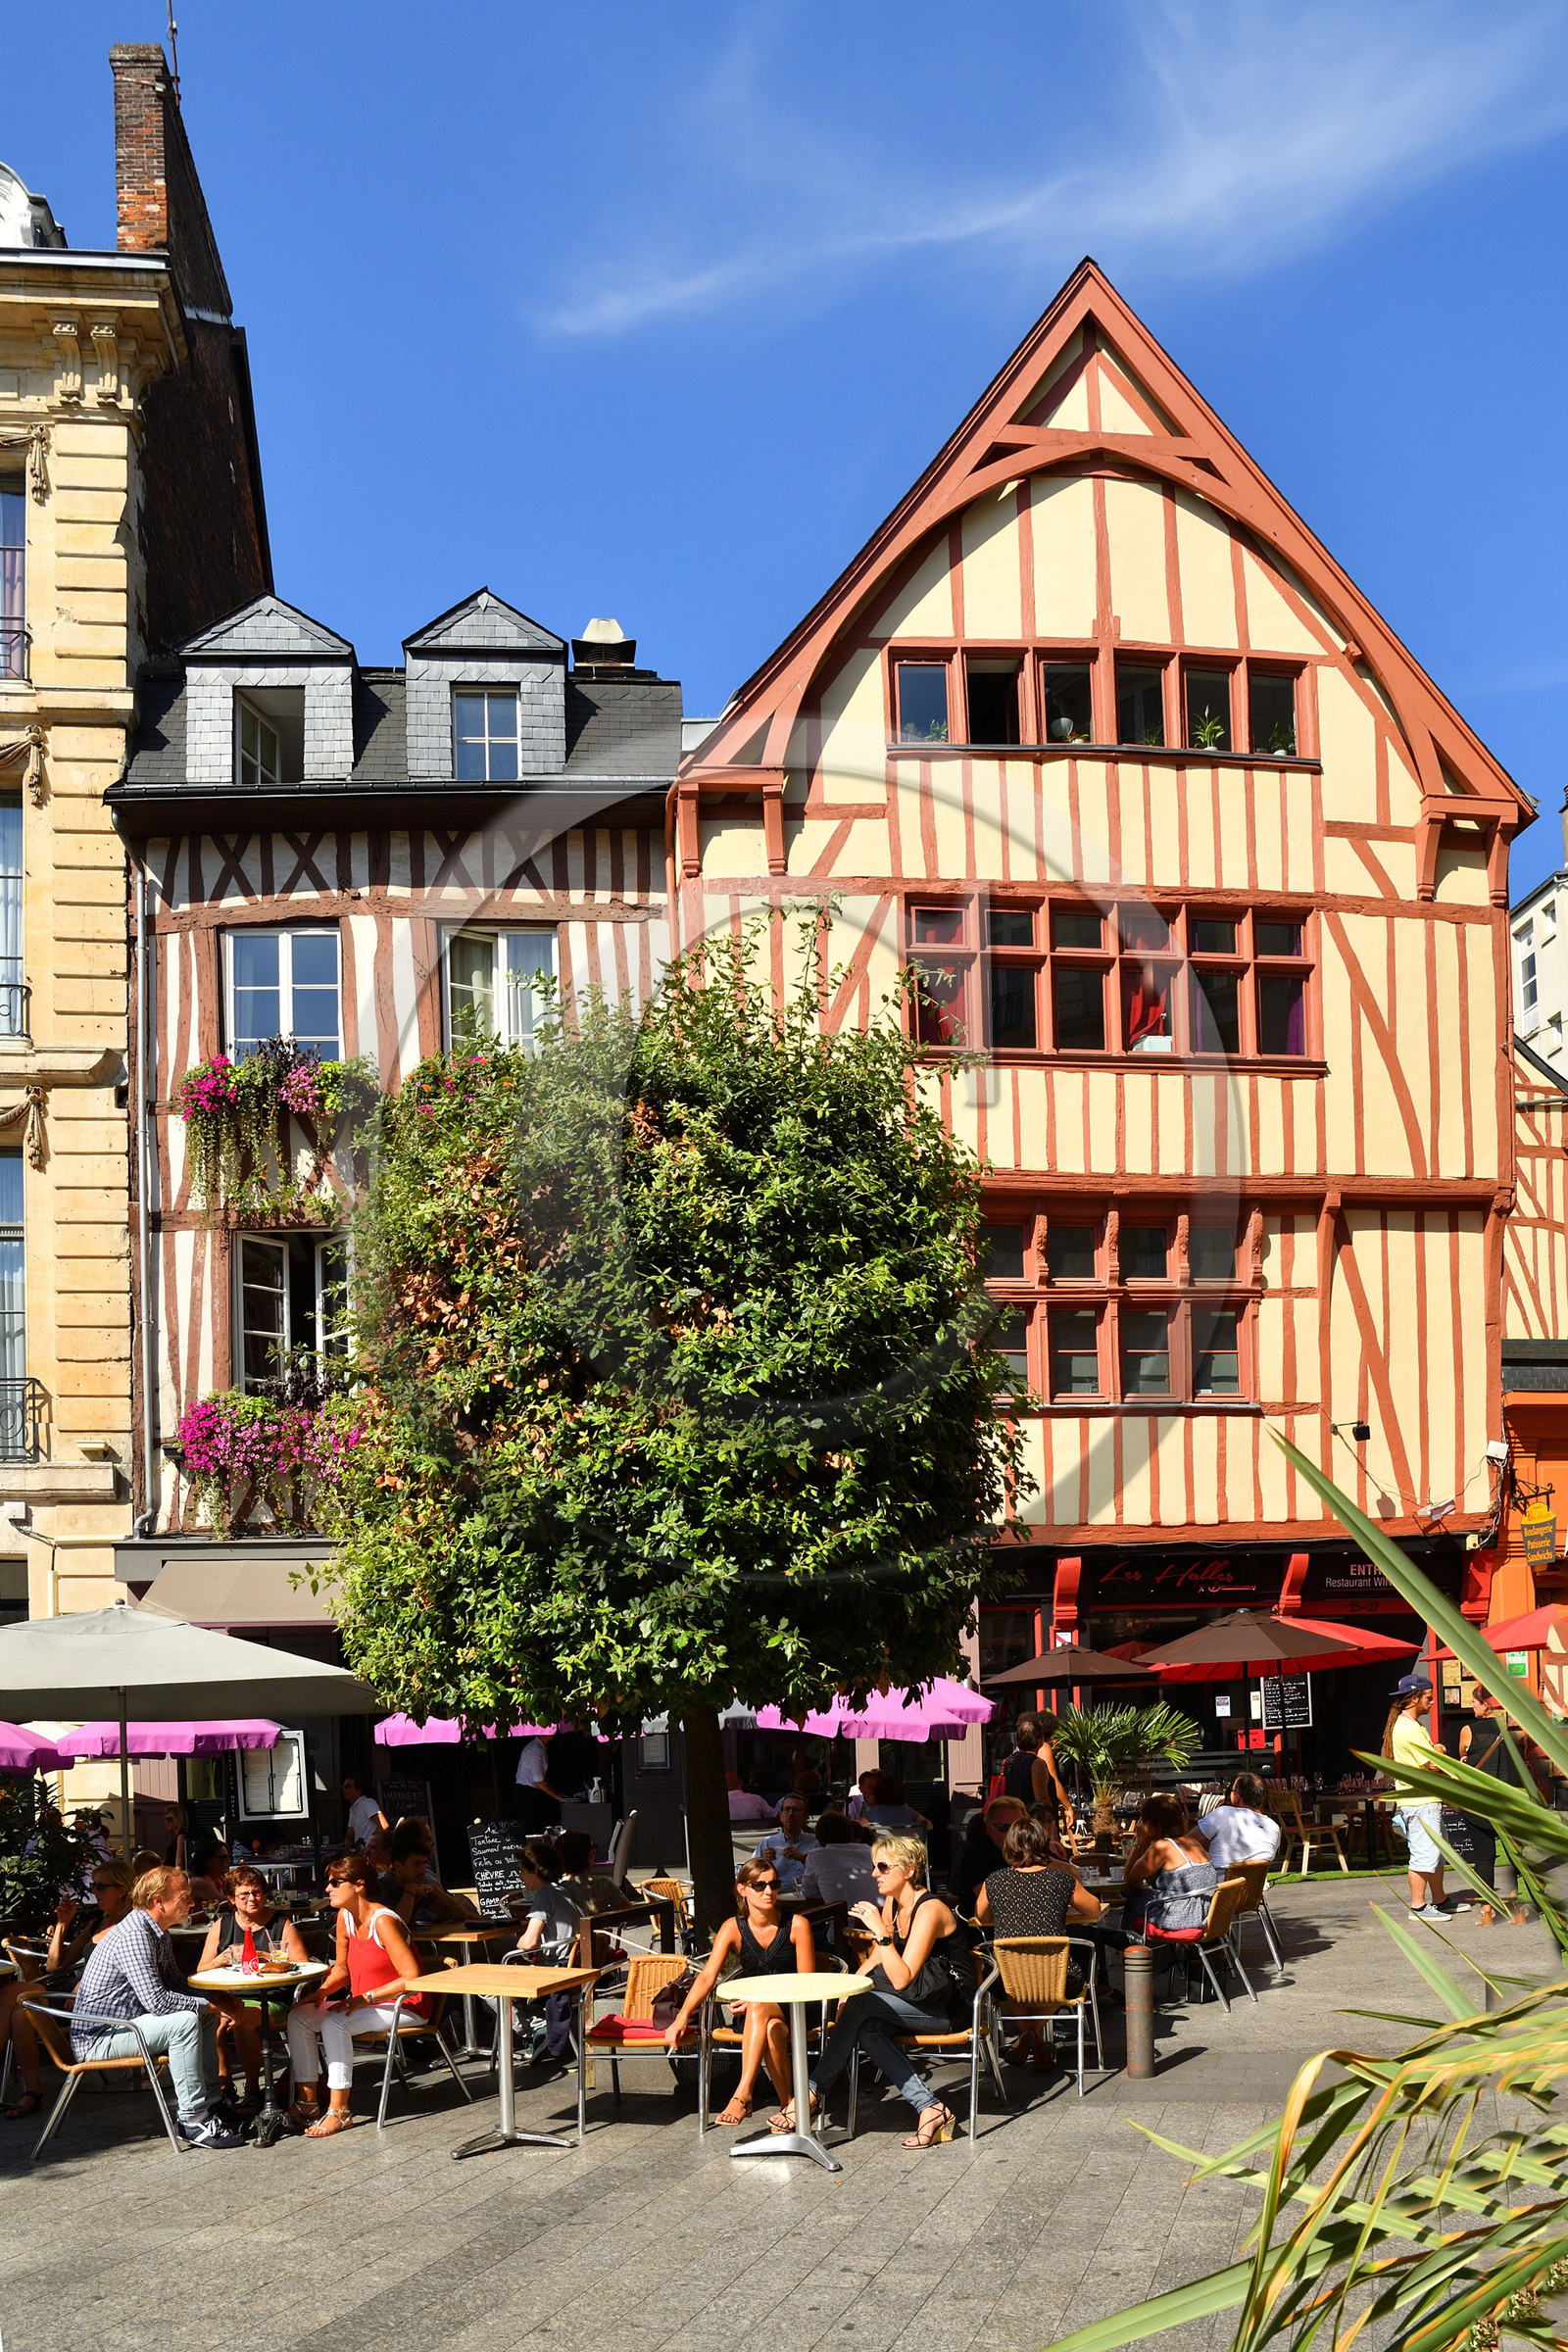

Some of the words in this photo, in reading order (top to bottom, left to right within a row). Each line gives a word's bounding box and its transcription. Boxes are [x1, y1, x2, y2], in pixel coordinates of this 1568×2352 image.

[1099, 1561, 1143, 1585] Les
[1154, 1560, 1235, 1587] Halles
[1350, 1564, 1383, 1576] ENTR
[1325, 1577, 1372, 1588] Restaurant
